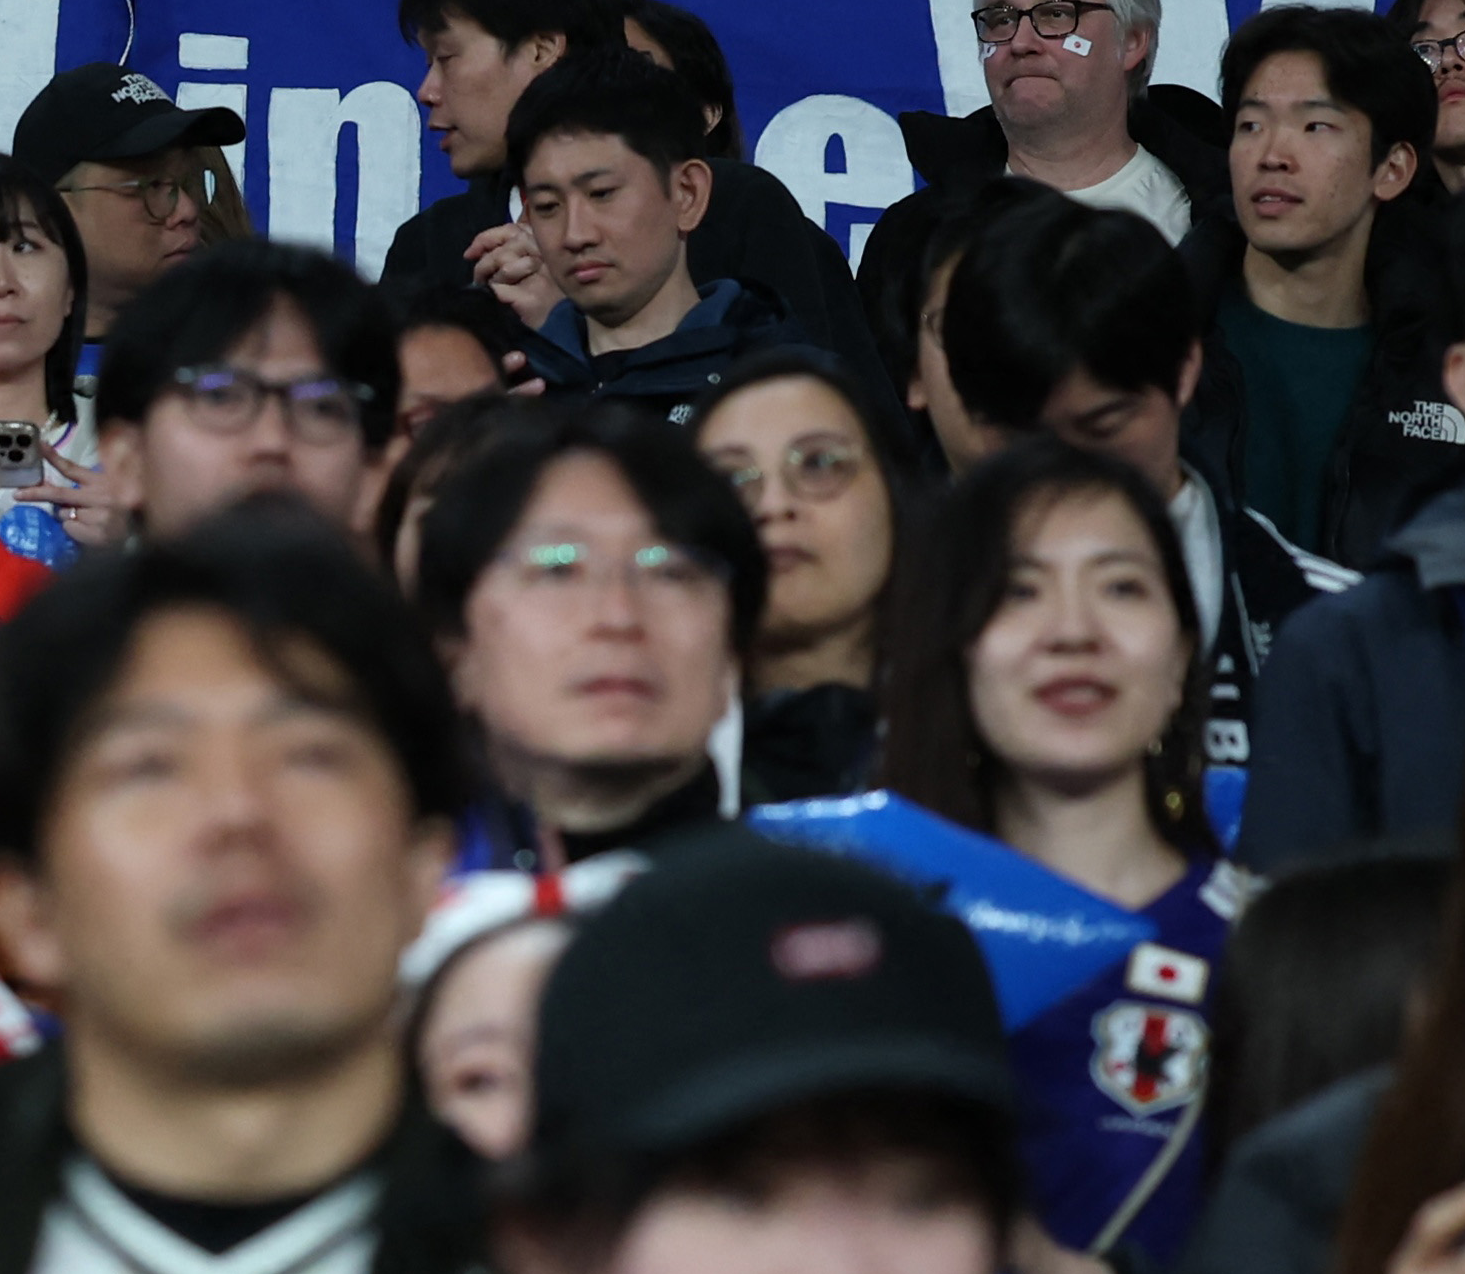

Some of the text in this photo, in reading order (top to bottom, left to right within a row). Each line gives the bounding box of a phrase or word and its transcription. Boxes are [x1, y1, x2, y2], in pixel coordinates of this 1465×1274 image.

[176, 32, 422, 285] in
[1413, 400, 1444, 416] THE
[1387, 410, 1443, 430] NORTH
[1402, 423, 1442, 441] FACE
